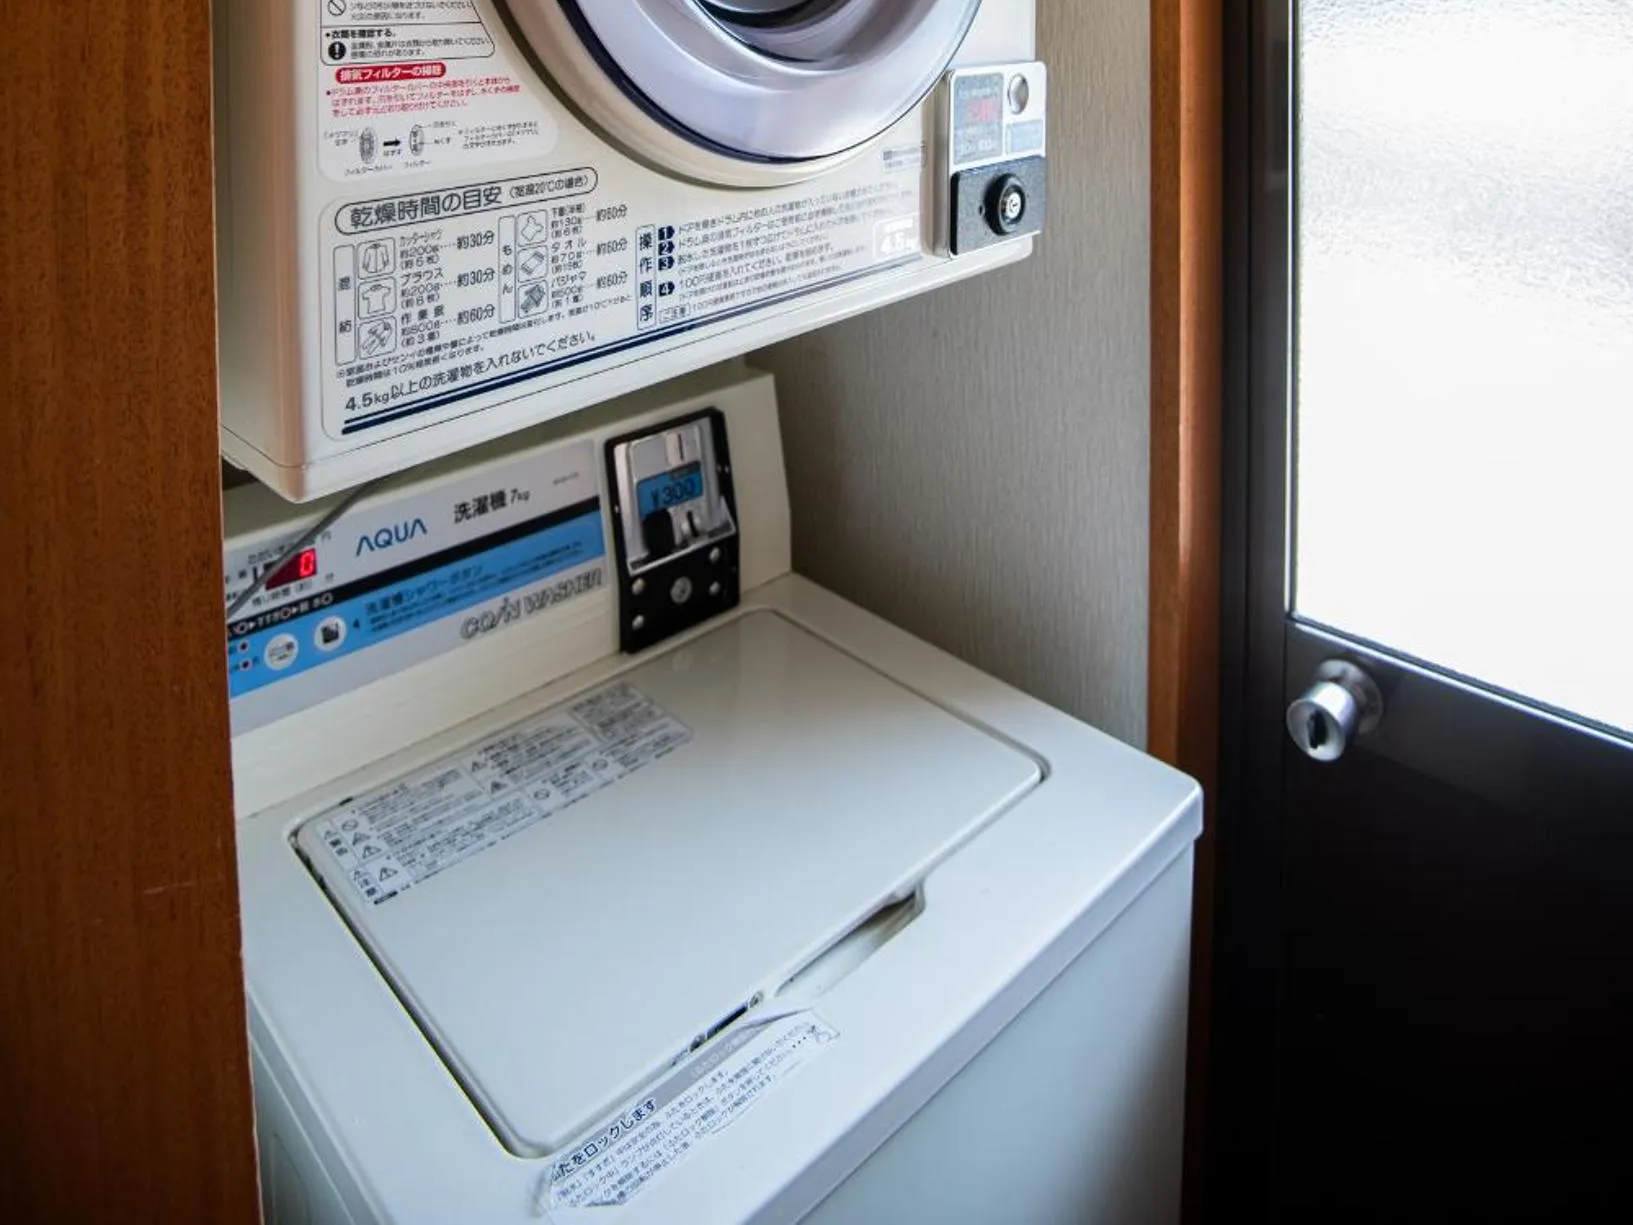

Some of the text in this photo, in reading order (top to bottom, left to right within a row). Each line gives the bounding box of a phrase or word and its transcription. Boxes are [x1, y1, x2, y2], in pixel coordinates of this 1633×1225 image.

[350, 186, 502, 229] 乾燥時間の目安
[454, 489, 507, 524] 洗濯機
[356, 518, 428, 557] AQUA
[300, 551, 314, 577] 0
